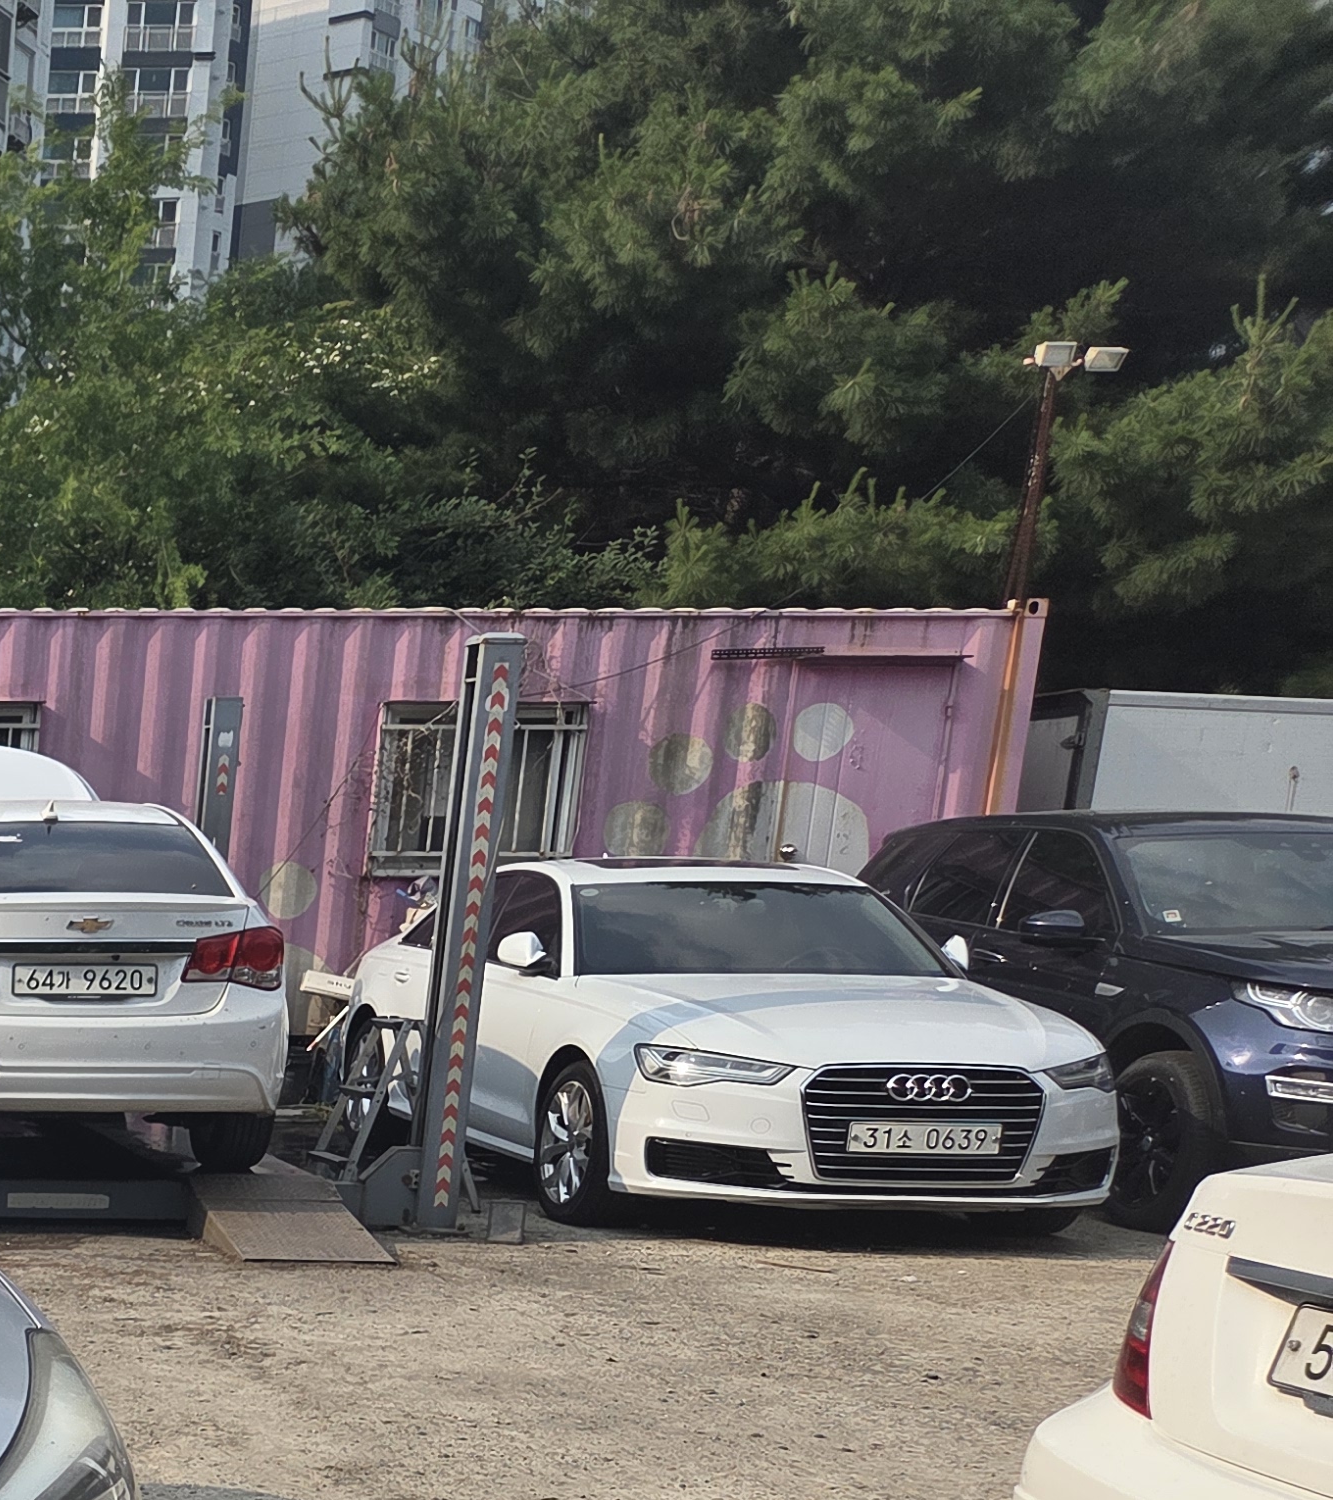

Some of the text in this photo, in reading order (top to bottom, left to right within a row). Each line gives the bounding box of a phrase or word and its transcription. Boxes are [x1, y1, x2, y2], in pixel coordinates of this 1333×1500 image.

[25, 968, 144, 991] 64가 9620
[862, 1127, 989, 1151] 31소 0639
